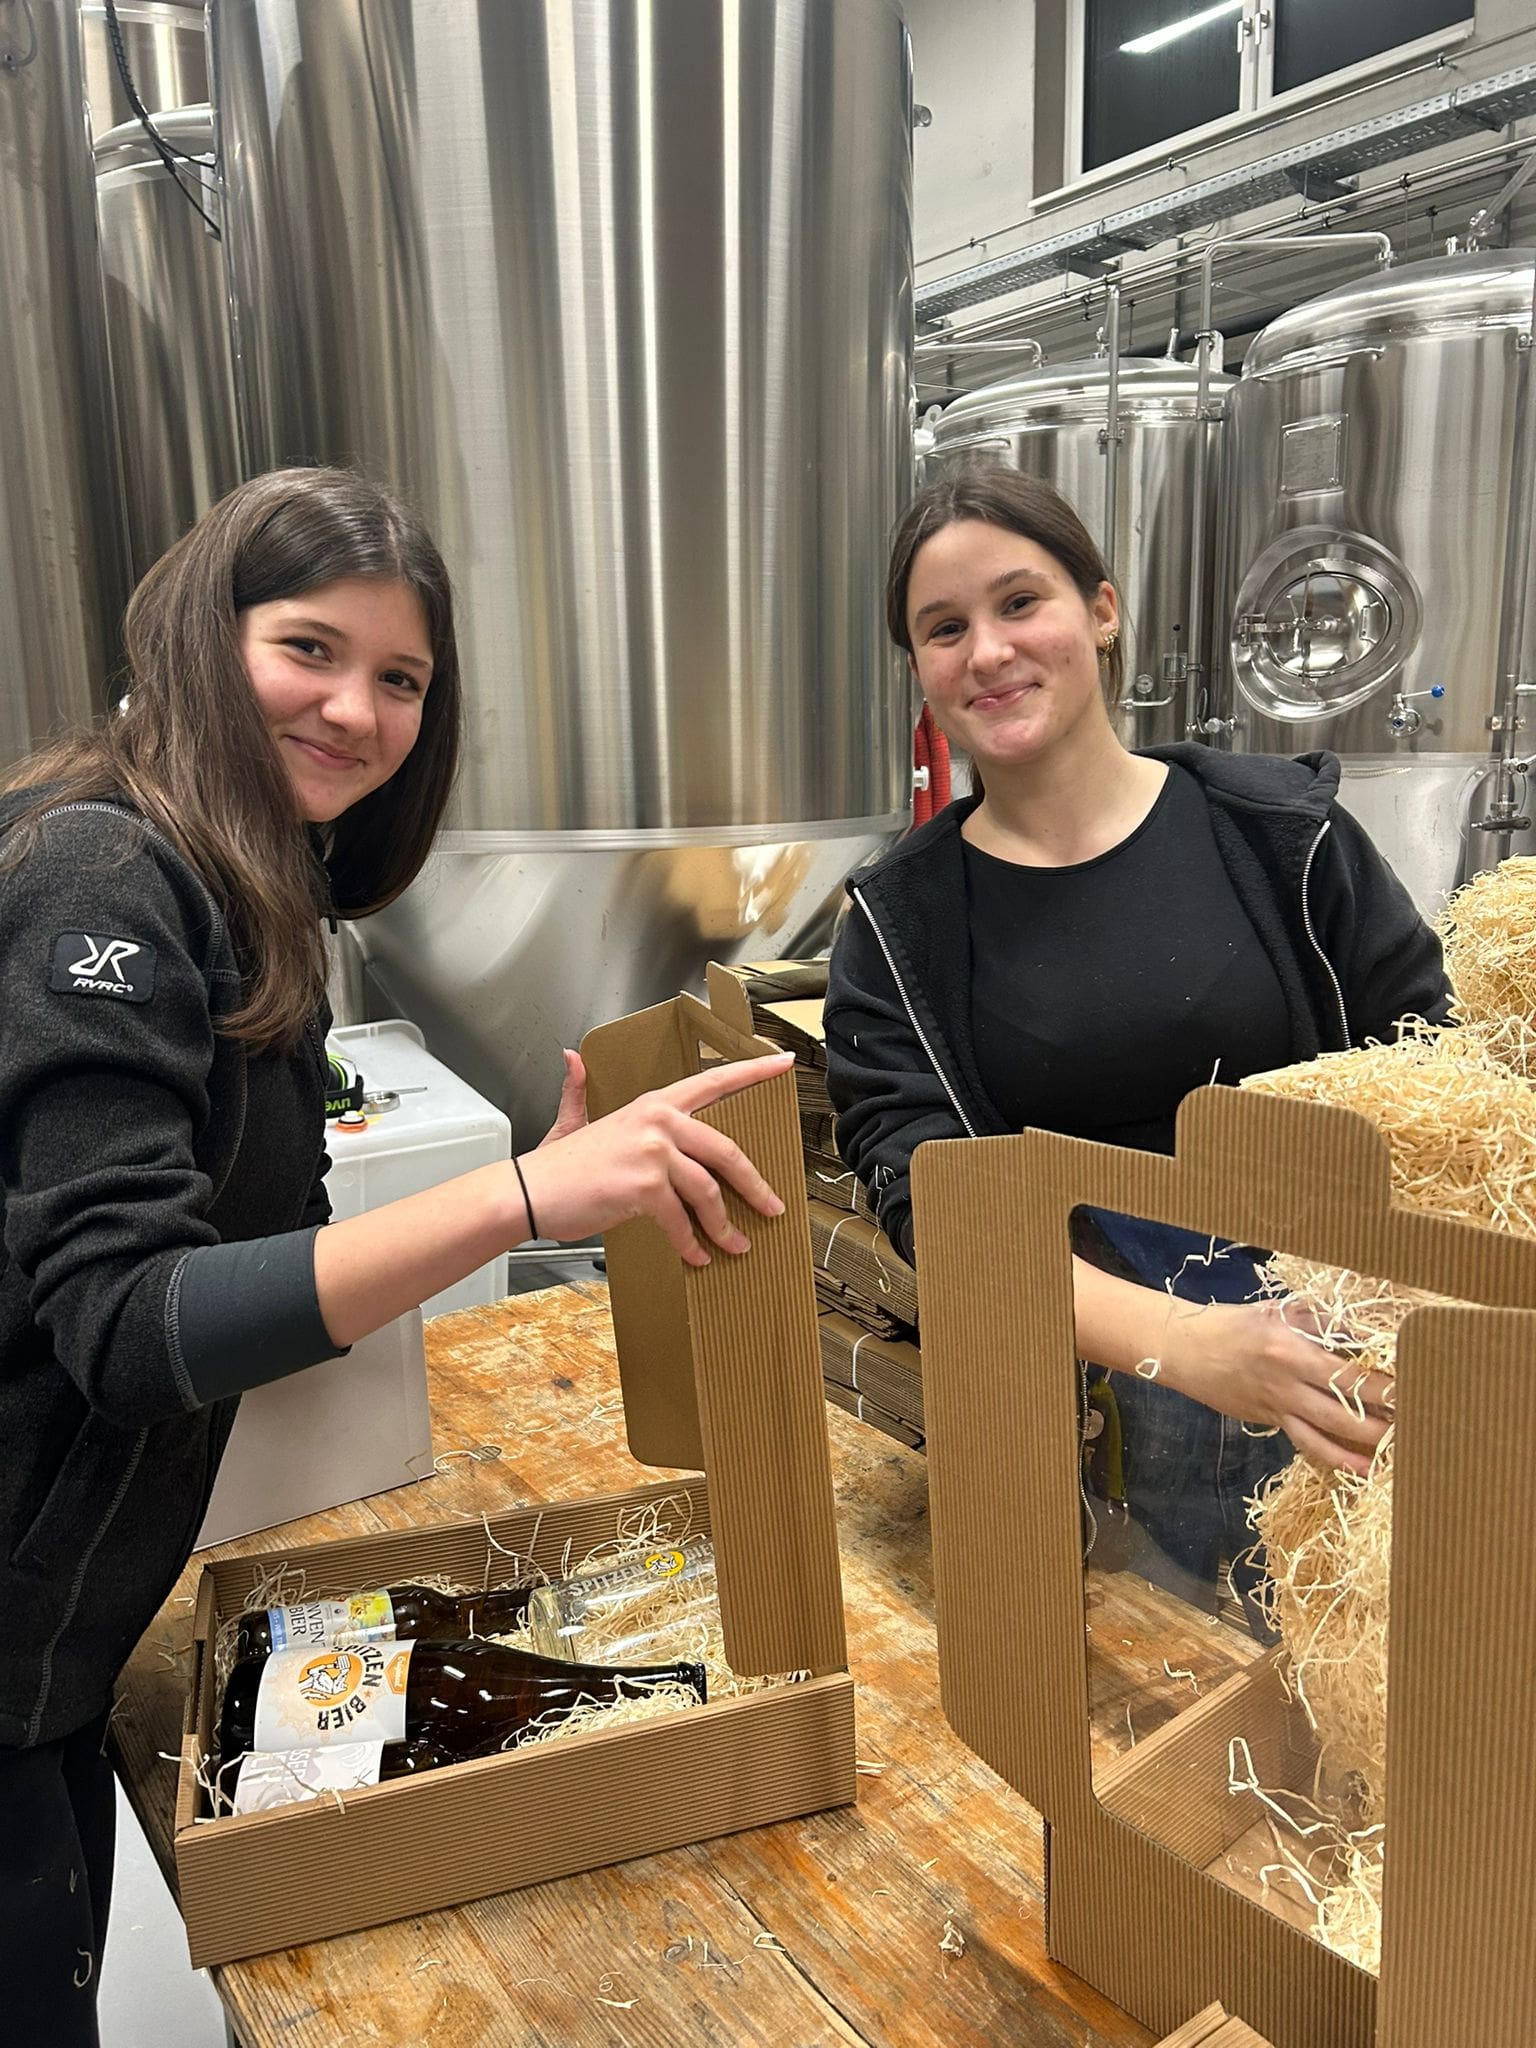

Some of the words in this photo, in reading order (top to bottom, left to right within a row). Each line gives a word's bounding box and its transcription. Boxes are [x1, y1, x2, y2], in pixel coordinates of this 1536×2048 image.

[325, 1097, 351, 1111] uve
[568, 1562, 647, 1597] SPITZEN
[682, 1542, 715, 1561] BIE
[289, 1606, 307, 1636] BIER
[317, 1694, 367, 1730] BIER
